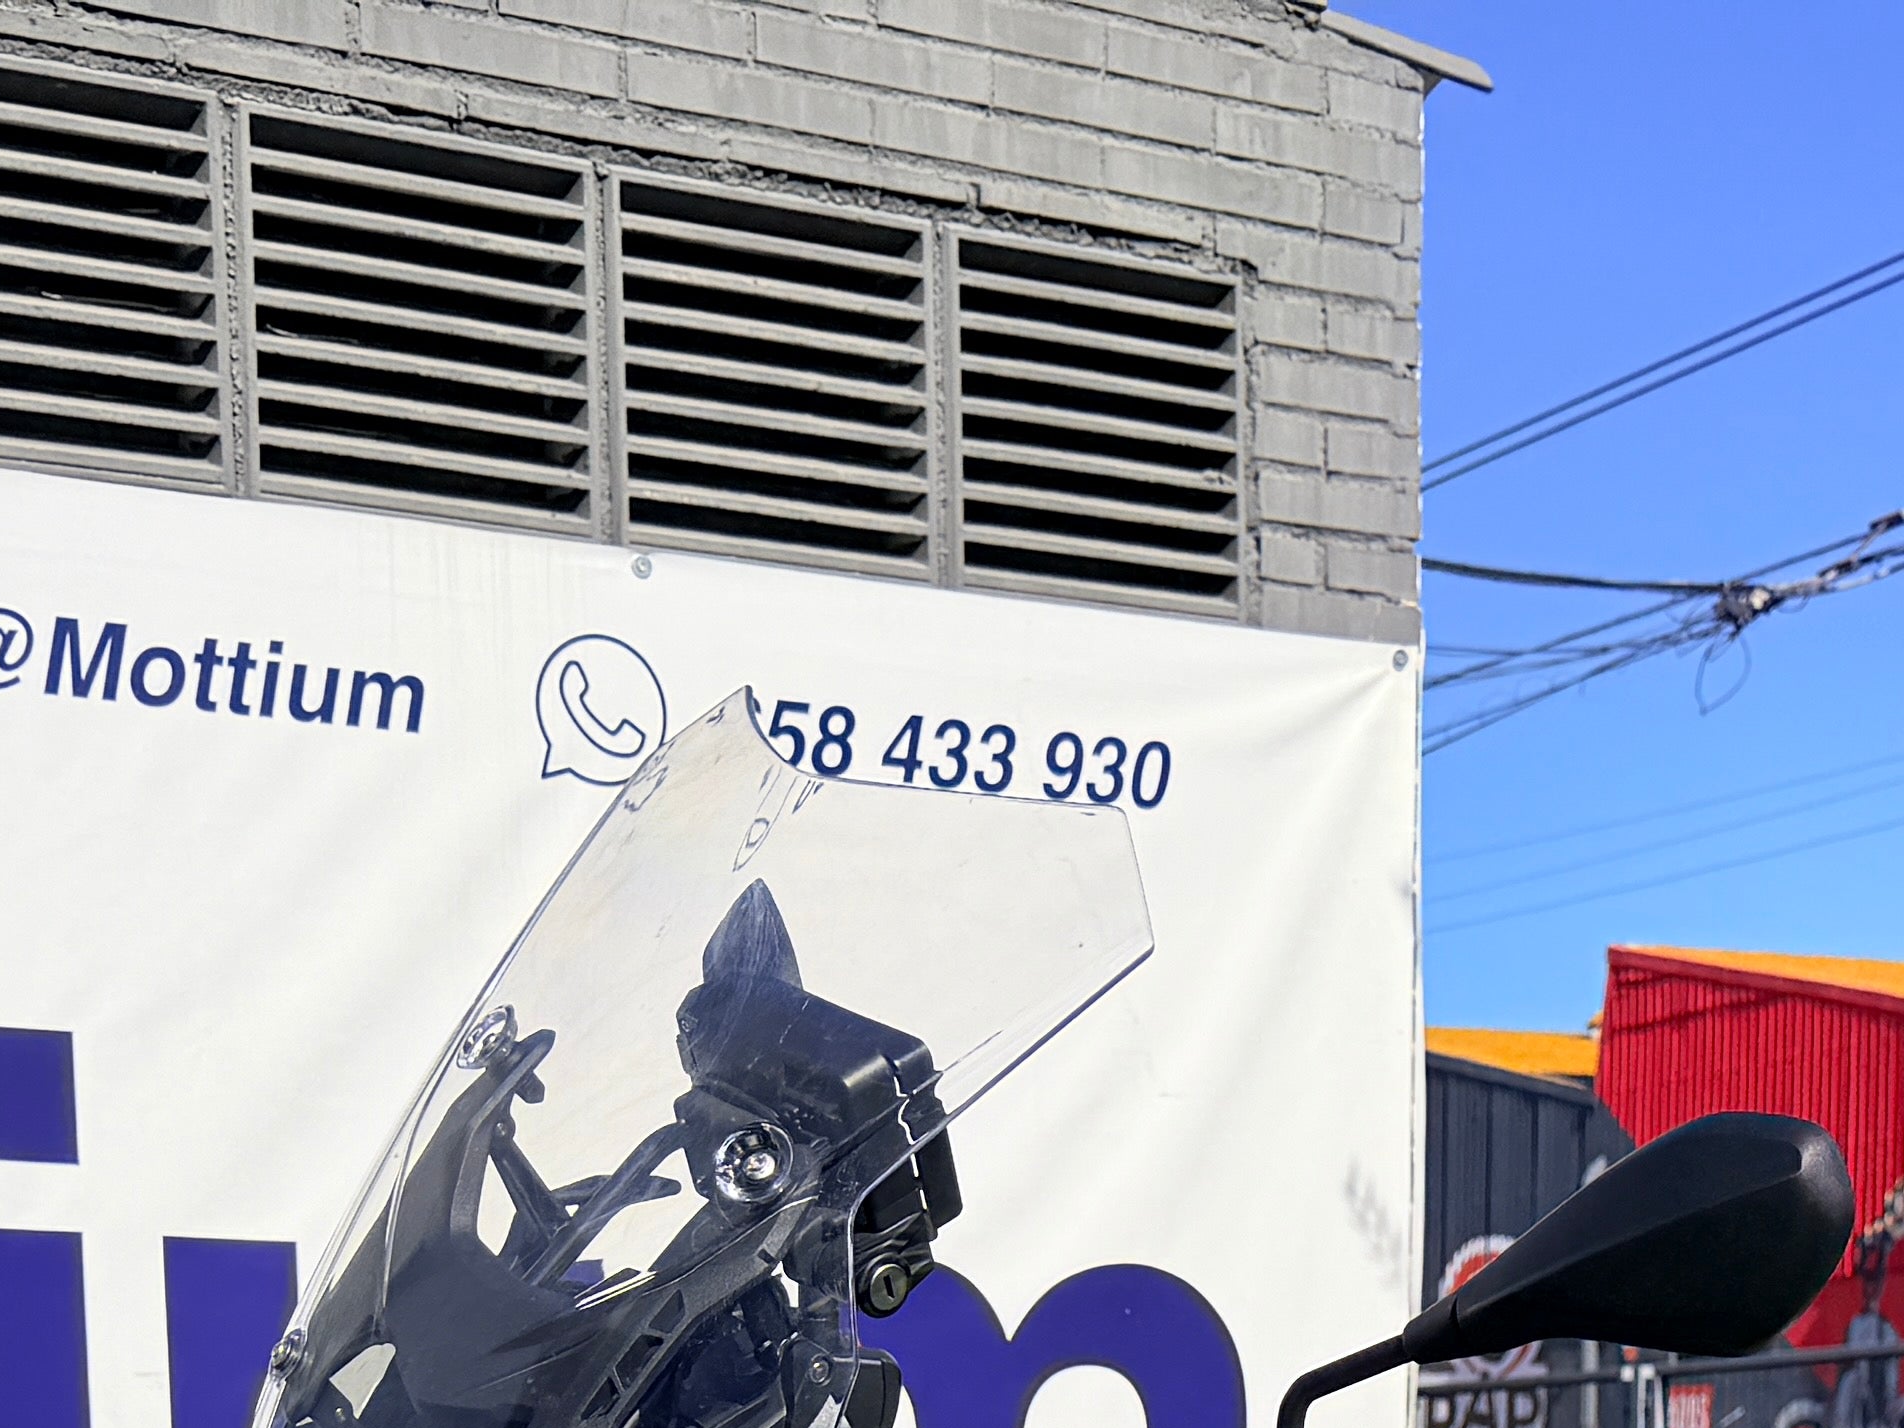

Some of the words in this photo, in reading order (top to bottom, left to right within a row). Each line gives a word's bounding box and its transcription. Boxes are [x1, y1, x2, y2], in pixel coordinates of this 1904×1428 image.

[752, 698, 857, 777] 58
[881, 714, 1016, 793] 433
[1042, 731, 1172, 809] 930
